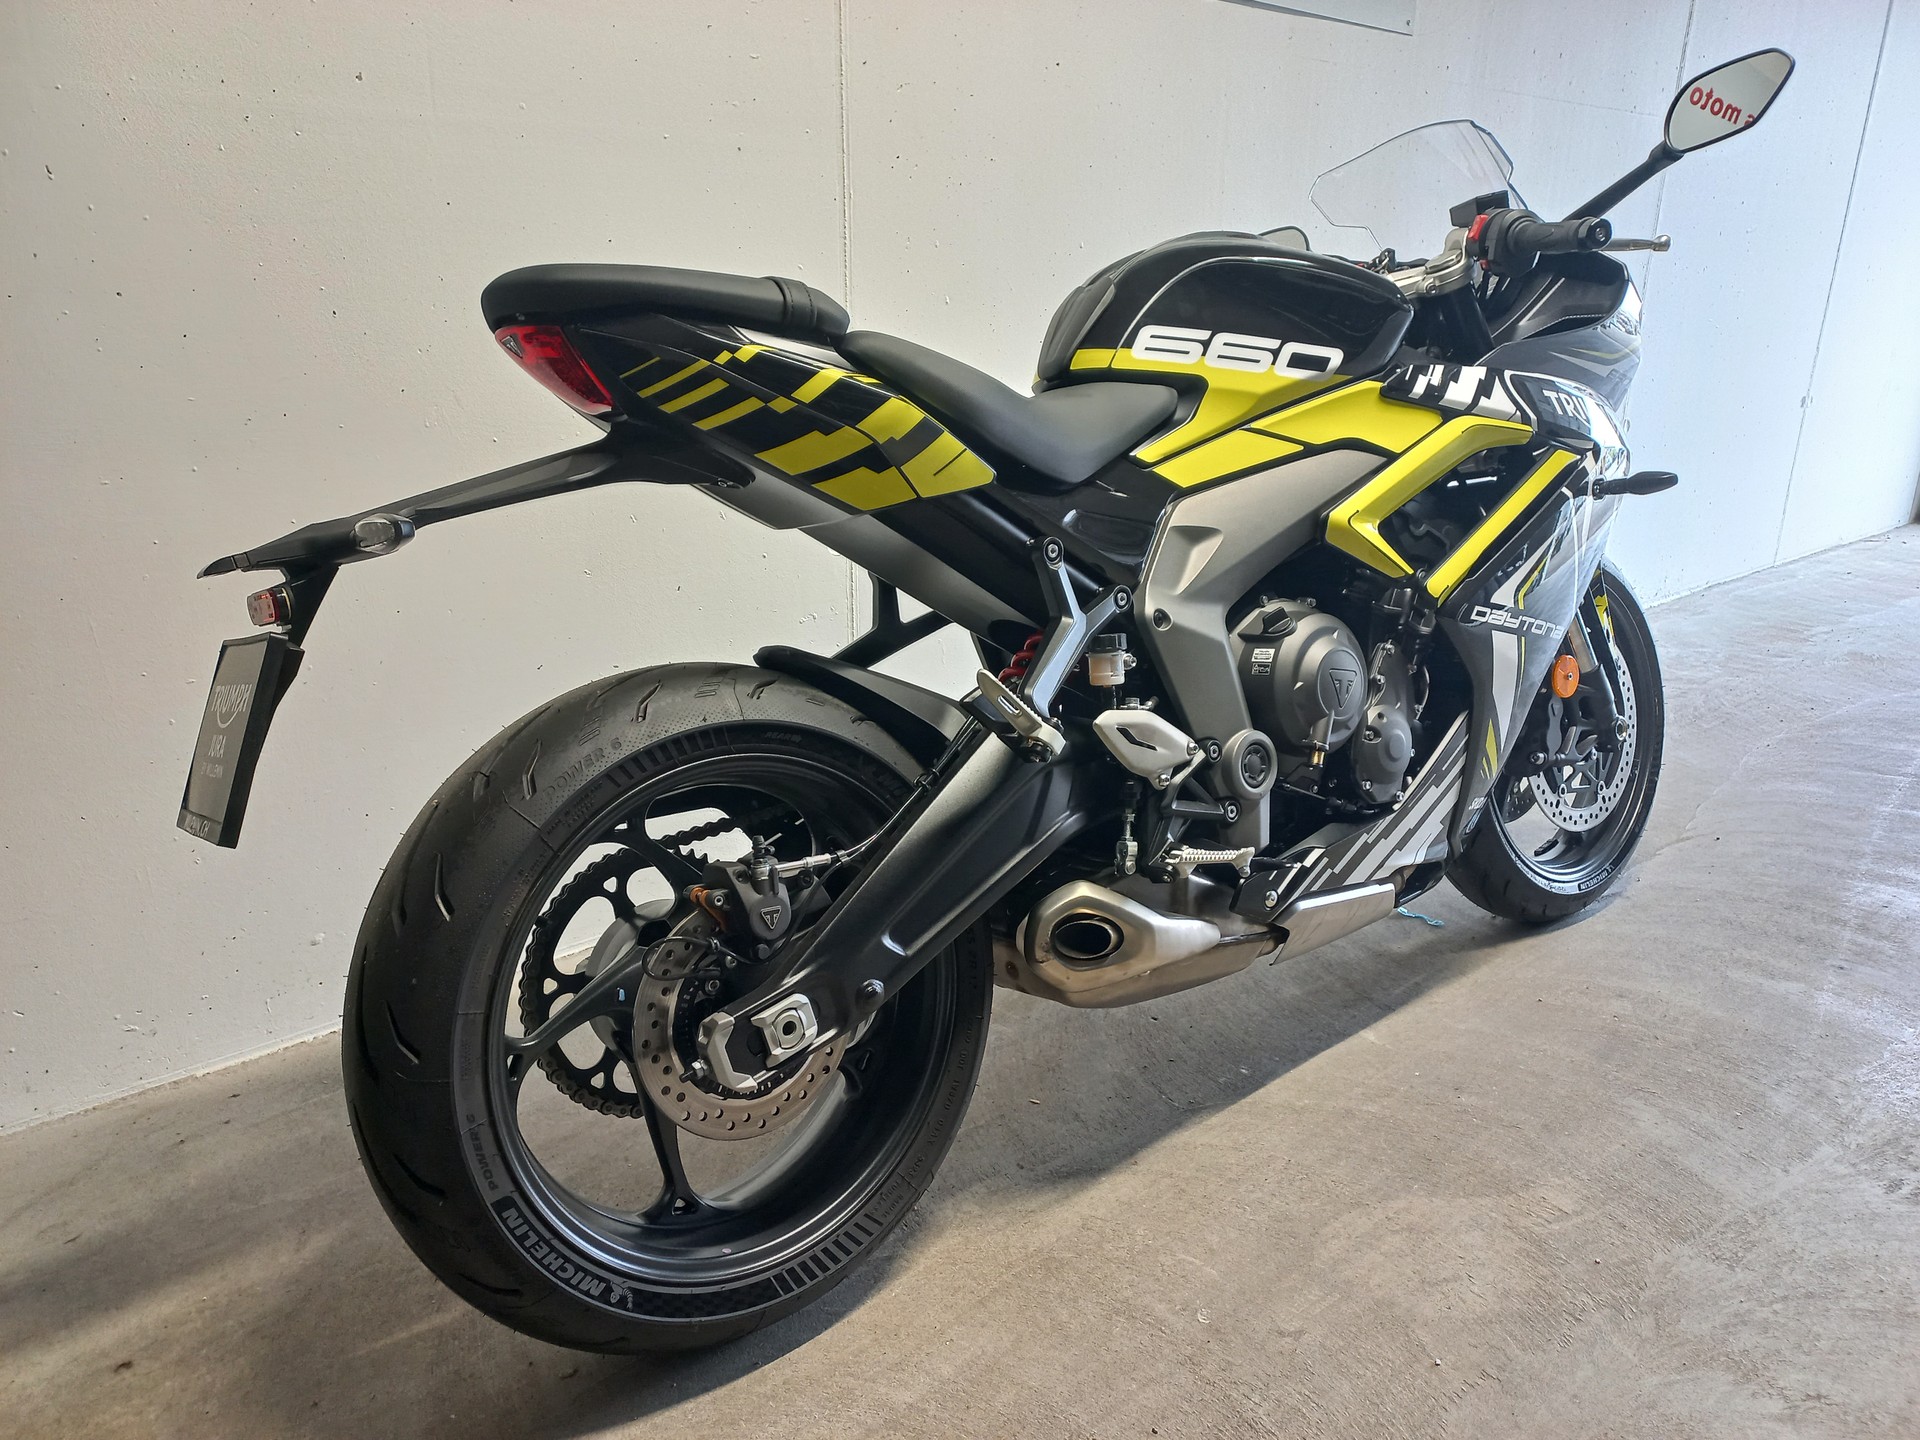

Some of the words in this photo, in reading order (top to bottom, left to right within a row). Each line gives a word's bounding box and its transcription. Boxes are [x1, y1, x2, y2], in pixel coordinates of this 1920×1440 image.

[1131, 325, 1344, 381] 660
[211, 683, 252, 728] TRIUMPH
[543, 747, 606, 799] POWER
[469, 1127, 499, 1191] POWER
[501, 1206, 607, 1298] MICHELIN
